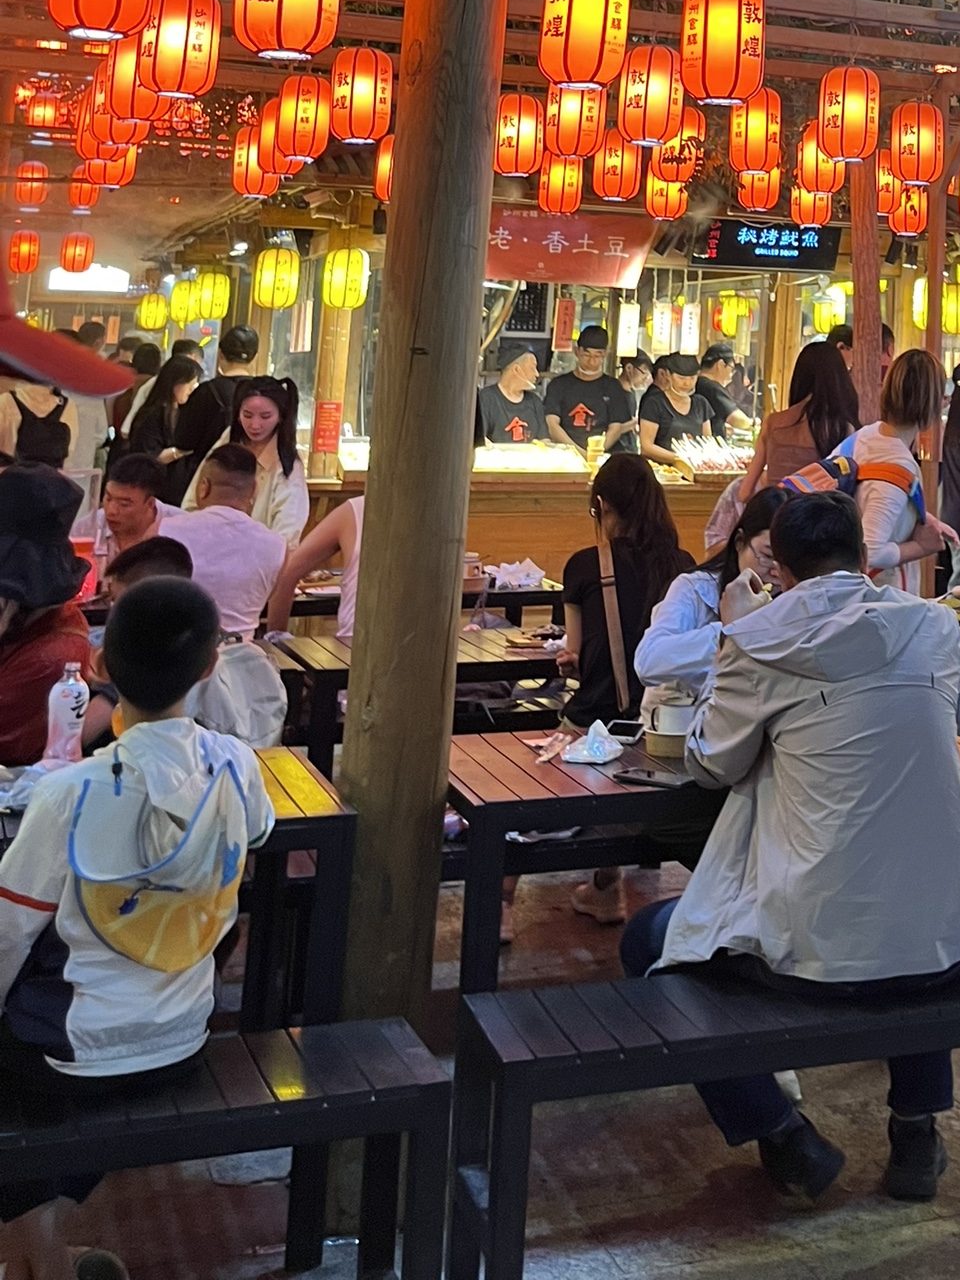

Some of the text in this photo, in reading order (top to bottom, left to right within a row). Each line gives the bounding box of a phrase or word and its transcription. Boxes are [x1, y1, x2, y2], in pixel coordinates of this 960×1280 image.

[742, 0, 763, 59] 敦煌
[333, 72, 350, 110] 敦煌
[627, 69, 645, 109] 敦煌
[826, 90, 841, 129] 敦煌
[500, 115, 516, 149] 敦煌
[901, 122, 916, 156] 敦煌
[605, 146, 619, 177] 敦煌
